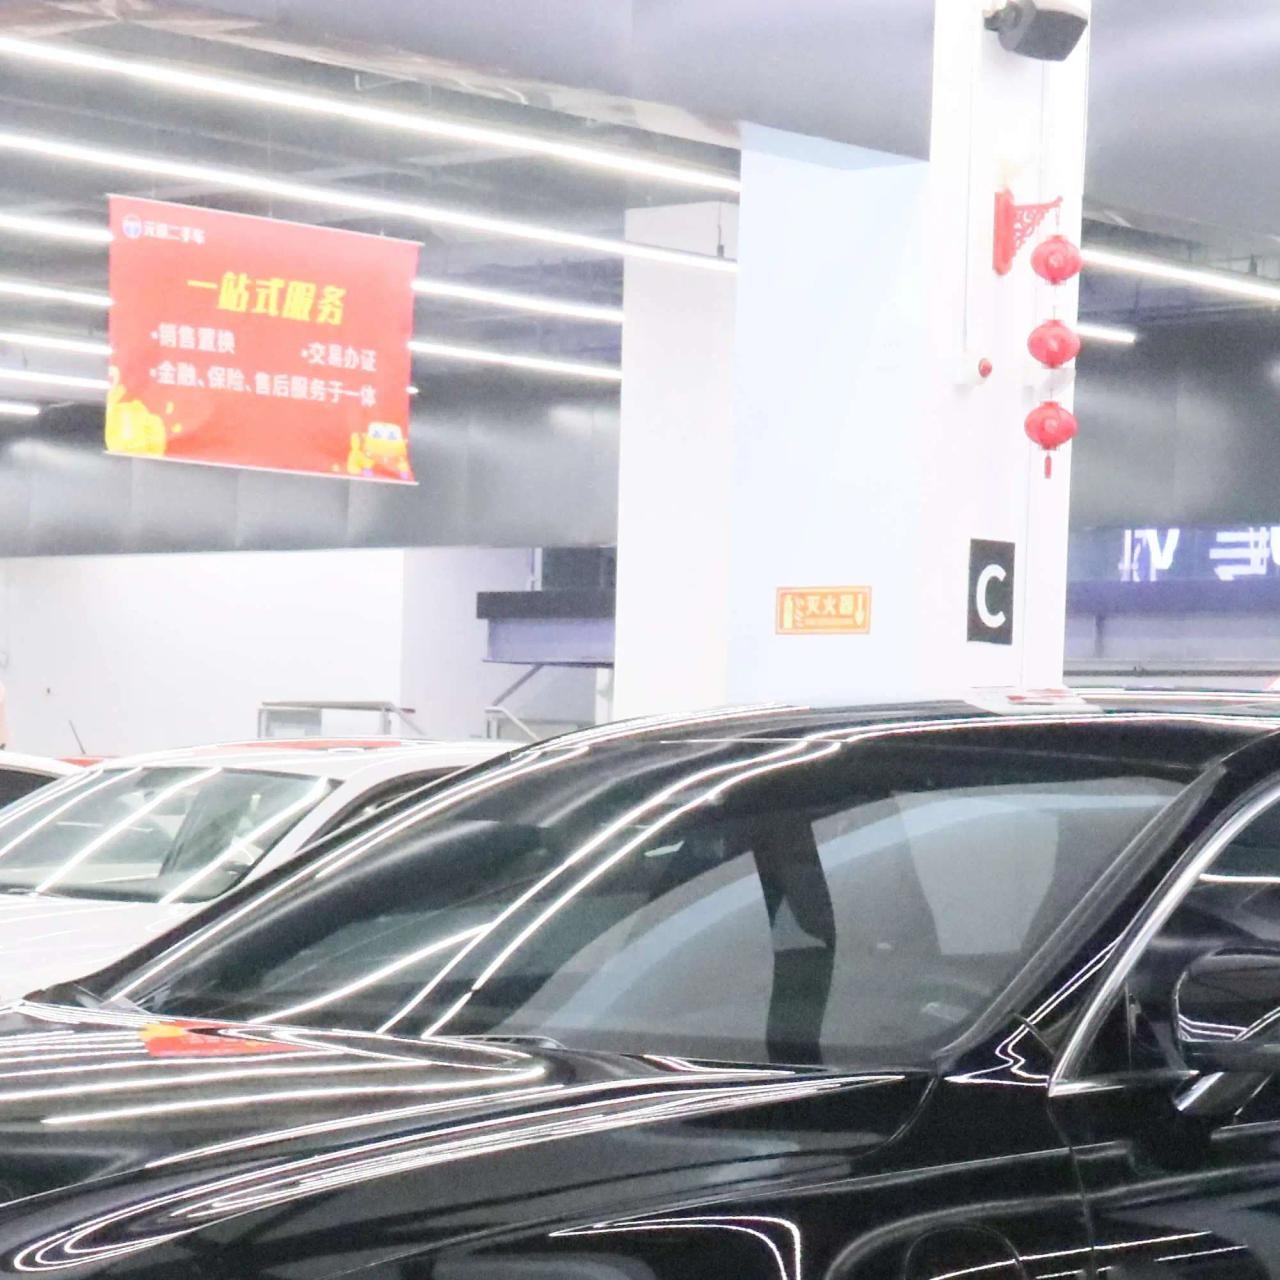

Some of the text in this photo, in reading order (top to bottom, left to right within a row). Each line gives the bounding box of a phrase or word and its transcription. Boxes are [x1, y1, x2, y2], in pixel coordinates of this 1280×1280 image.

[187, 270, 346, 325] 一站式服务
[158, 322, 236, 355] 销售置换
[307, 342, 378, 373] 交易办证
[805, 594, 855, 616] 灭火器
[976, 563, 1007, 629] C
